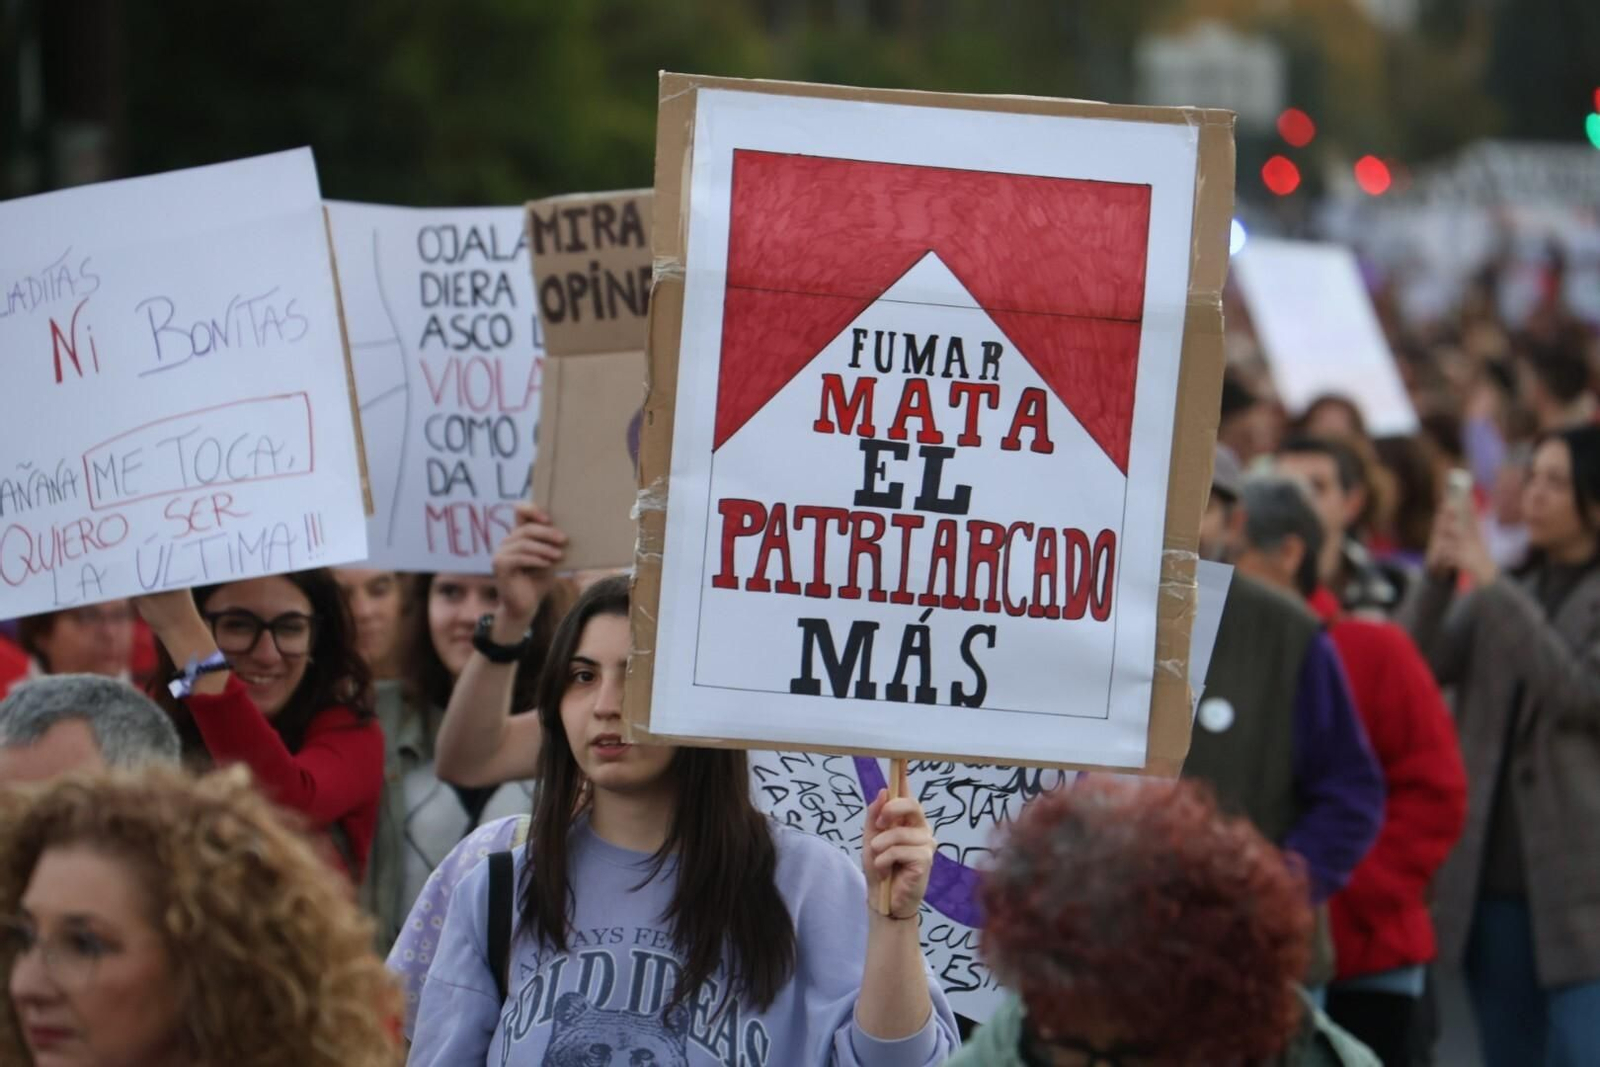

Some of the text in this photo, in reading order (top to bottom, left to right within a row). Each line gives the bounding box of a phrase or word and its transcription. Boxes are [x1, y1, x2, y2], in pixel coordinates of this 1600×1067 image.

[531, 200, 646, 255] MIRA
[420, 271, 517, 309] DIERA
[419, 312, 513, 351] ASCO
[848, 327, 1004, 381] FUMAR
[424, 414, 519, 459] COMO
[813, 373, 1055, 455] MATA
[0, 456, 79, 518] AÑANA
[92, 448, 142, 501] ME
[427, 458, 477, 497] DA
[853, 438, 973, 516] EL
[0, 491, 250, 587] QUIERO SER
[424, 500, 515, 555] MENS
[52, 562, 107, 607] LA
[711, 497, 1117, 623] PATRIARCADO
[789, 607, 998, 709] MÁS
